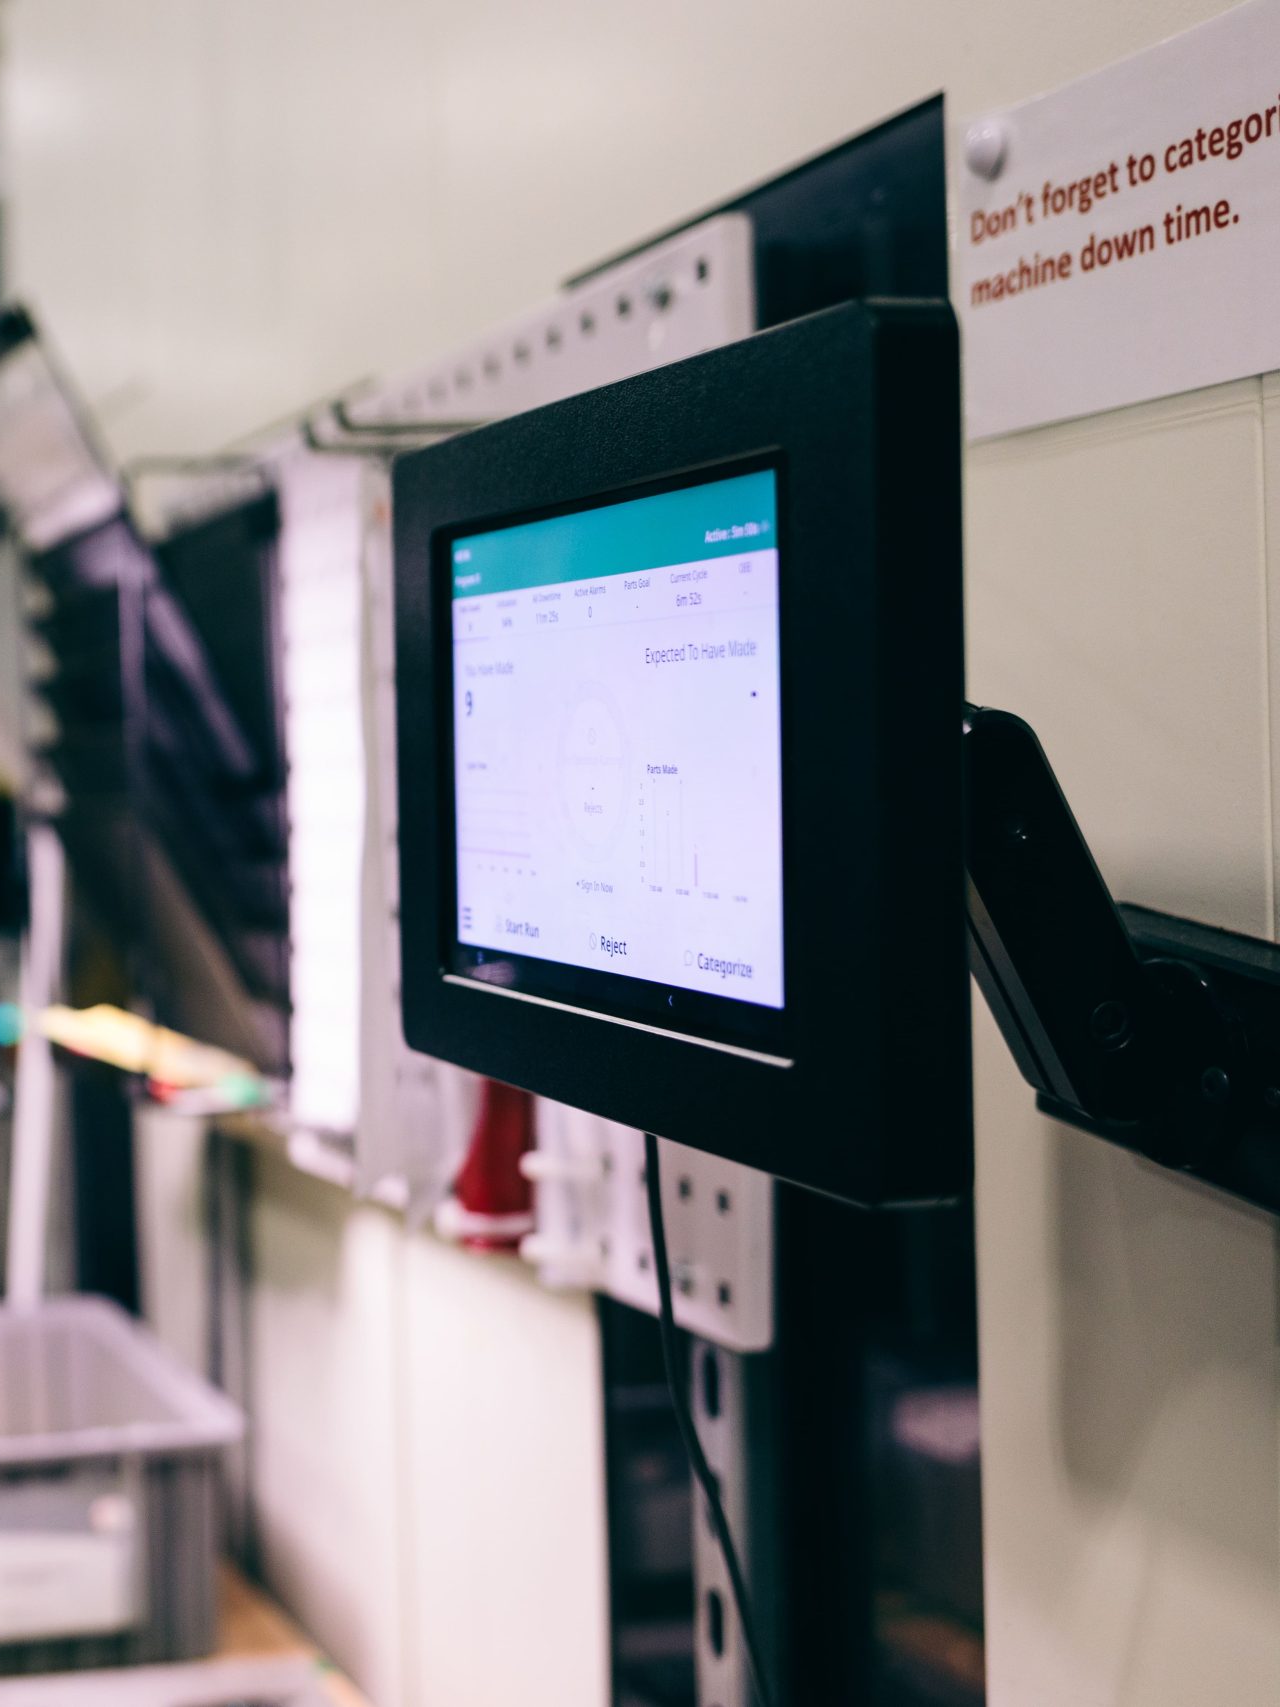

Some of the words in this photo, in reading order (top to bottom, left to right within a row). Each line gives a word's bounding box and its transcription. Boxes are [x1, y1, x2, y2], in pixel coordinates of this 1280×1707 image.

[970, 193, 1034, 246] Don't
[1041, 162, 1119, 218] forget
[1126, 154, 1156, 188] to
[970, 252, 1072, 309] machine
[1080, 224, 1155, 273] down
[1163, 199, 1240, 247] time.
[624, 579, 637, 591] Parts
[638, 577, 651, 589] Goal
[670, 572, 691, 585] Current
[692, 569, 708, 583] Cycle
[574, 586, 589, 597] Active
[589, 583, 606, 596] Alarms
[676, 594, 688, 607] 6m
[645, 643, 685, 668] Expected
[688, 643, 699, 661] To
[701, 642, 726, 660] Have
[728, 638, 757, 657] Made
[465, 689, 473, 717] 9
[647, 763, 662, 775] Parts
[662, 764, 679, 776] Made
[581, 879, 594, 893] Sign
[594, 881, 600, 892] In
[600, 882, 614, 895] Now
[505, 918, 524, 936] Start
[524, 922, 540, 939] Run
[600, 935, 628, 957] Reject
[697, 952, 753, 979] Categorize
